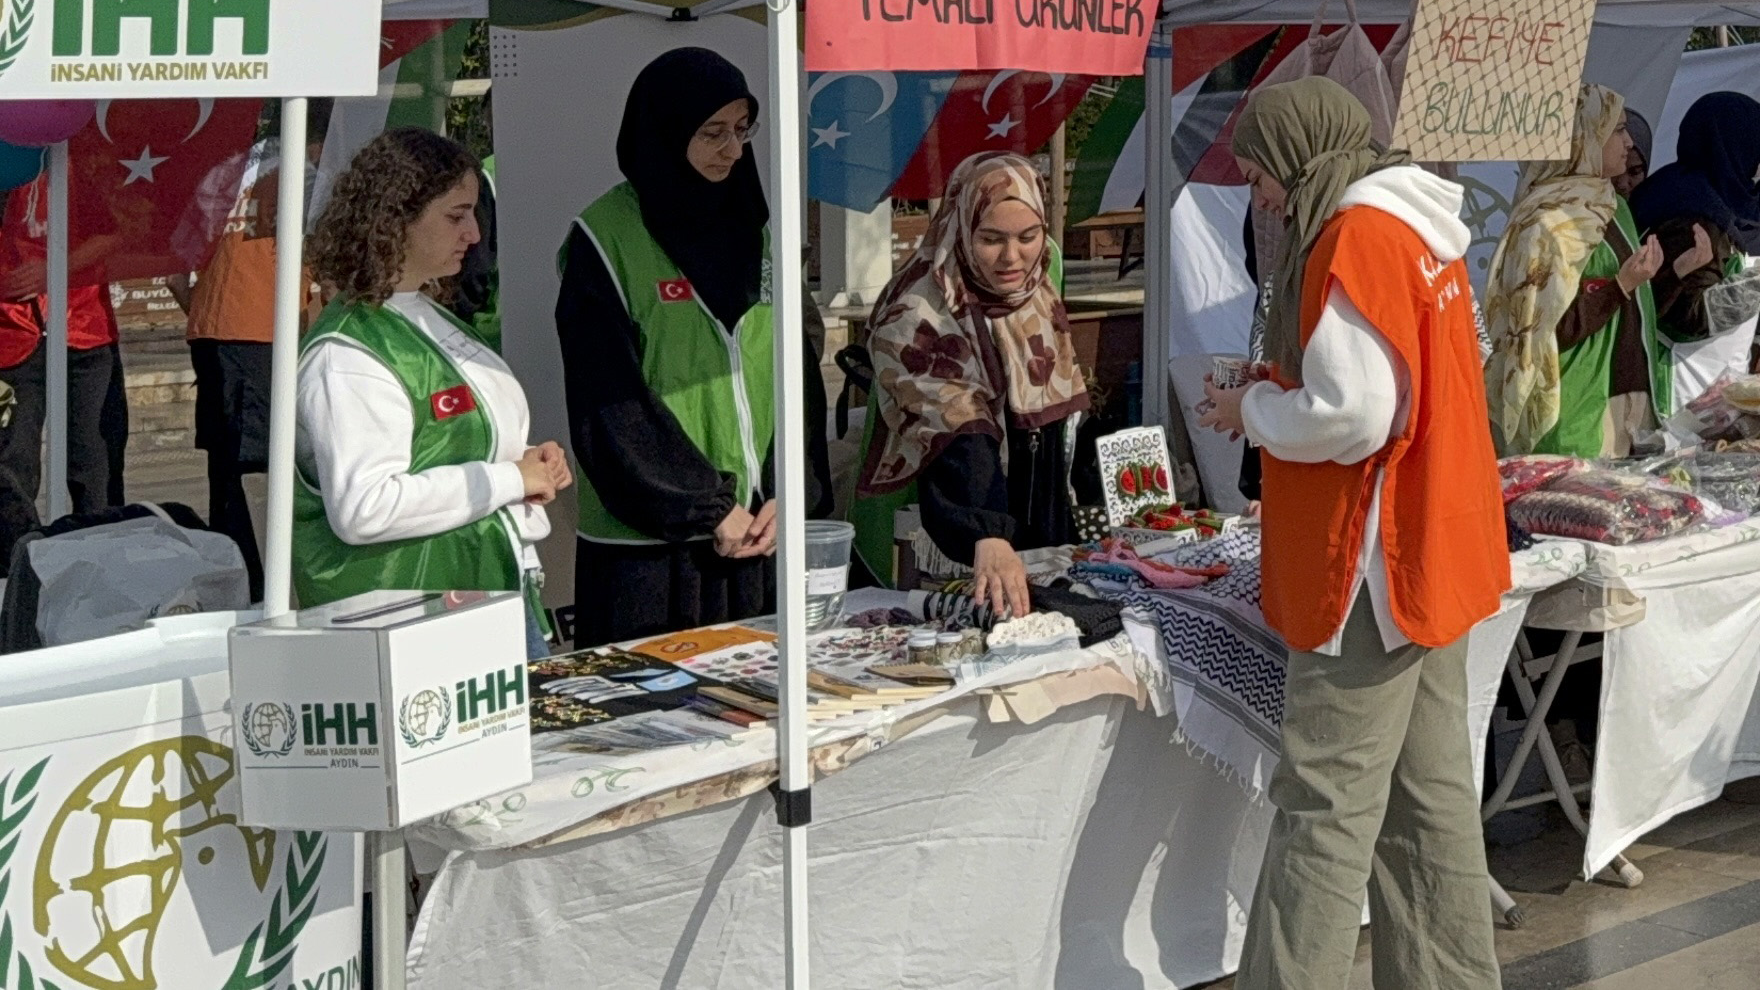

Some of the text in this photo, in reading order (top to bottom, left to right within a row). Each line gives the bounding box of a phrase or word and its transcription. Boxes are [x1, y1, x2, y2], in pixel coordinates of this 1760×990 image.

[130, 62, 207, 81] YARDIM
[212, 61, 269, 80] VAKFI
[1423, 81, 1564, 138] BULUNUR
[481, 723, 508, 738] AYDIN
[330, 758, 359, 768] AYDIN
[287, 950, 361, 990] YDIN
